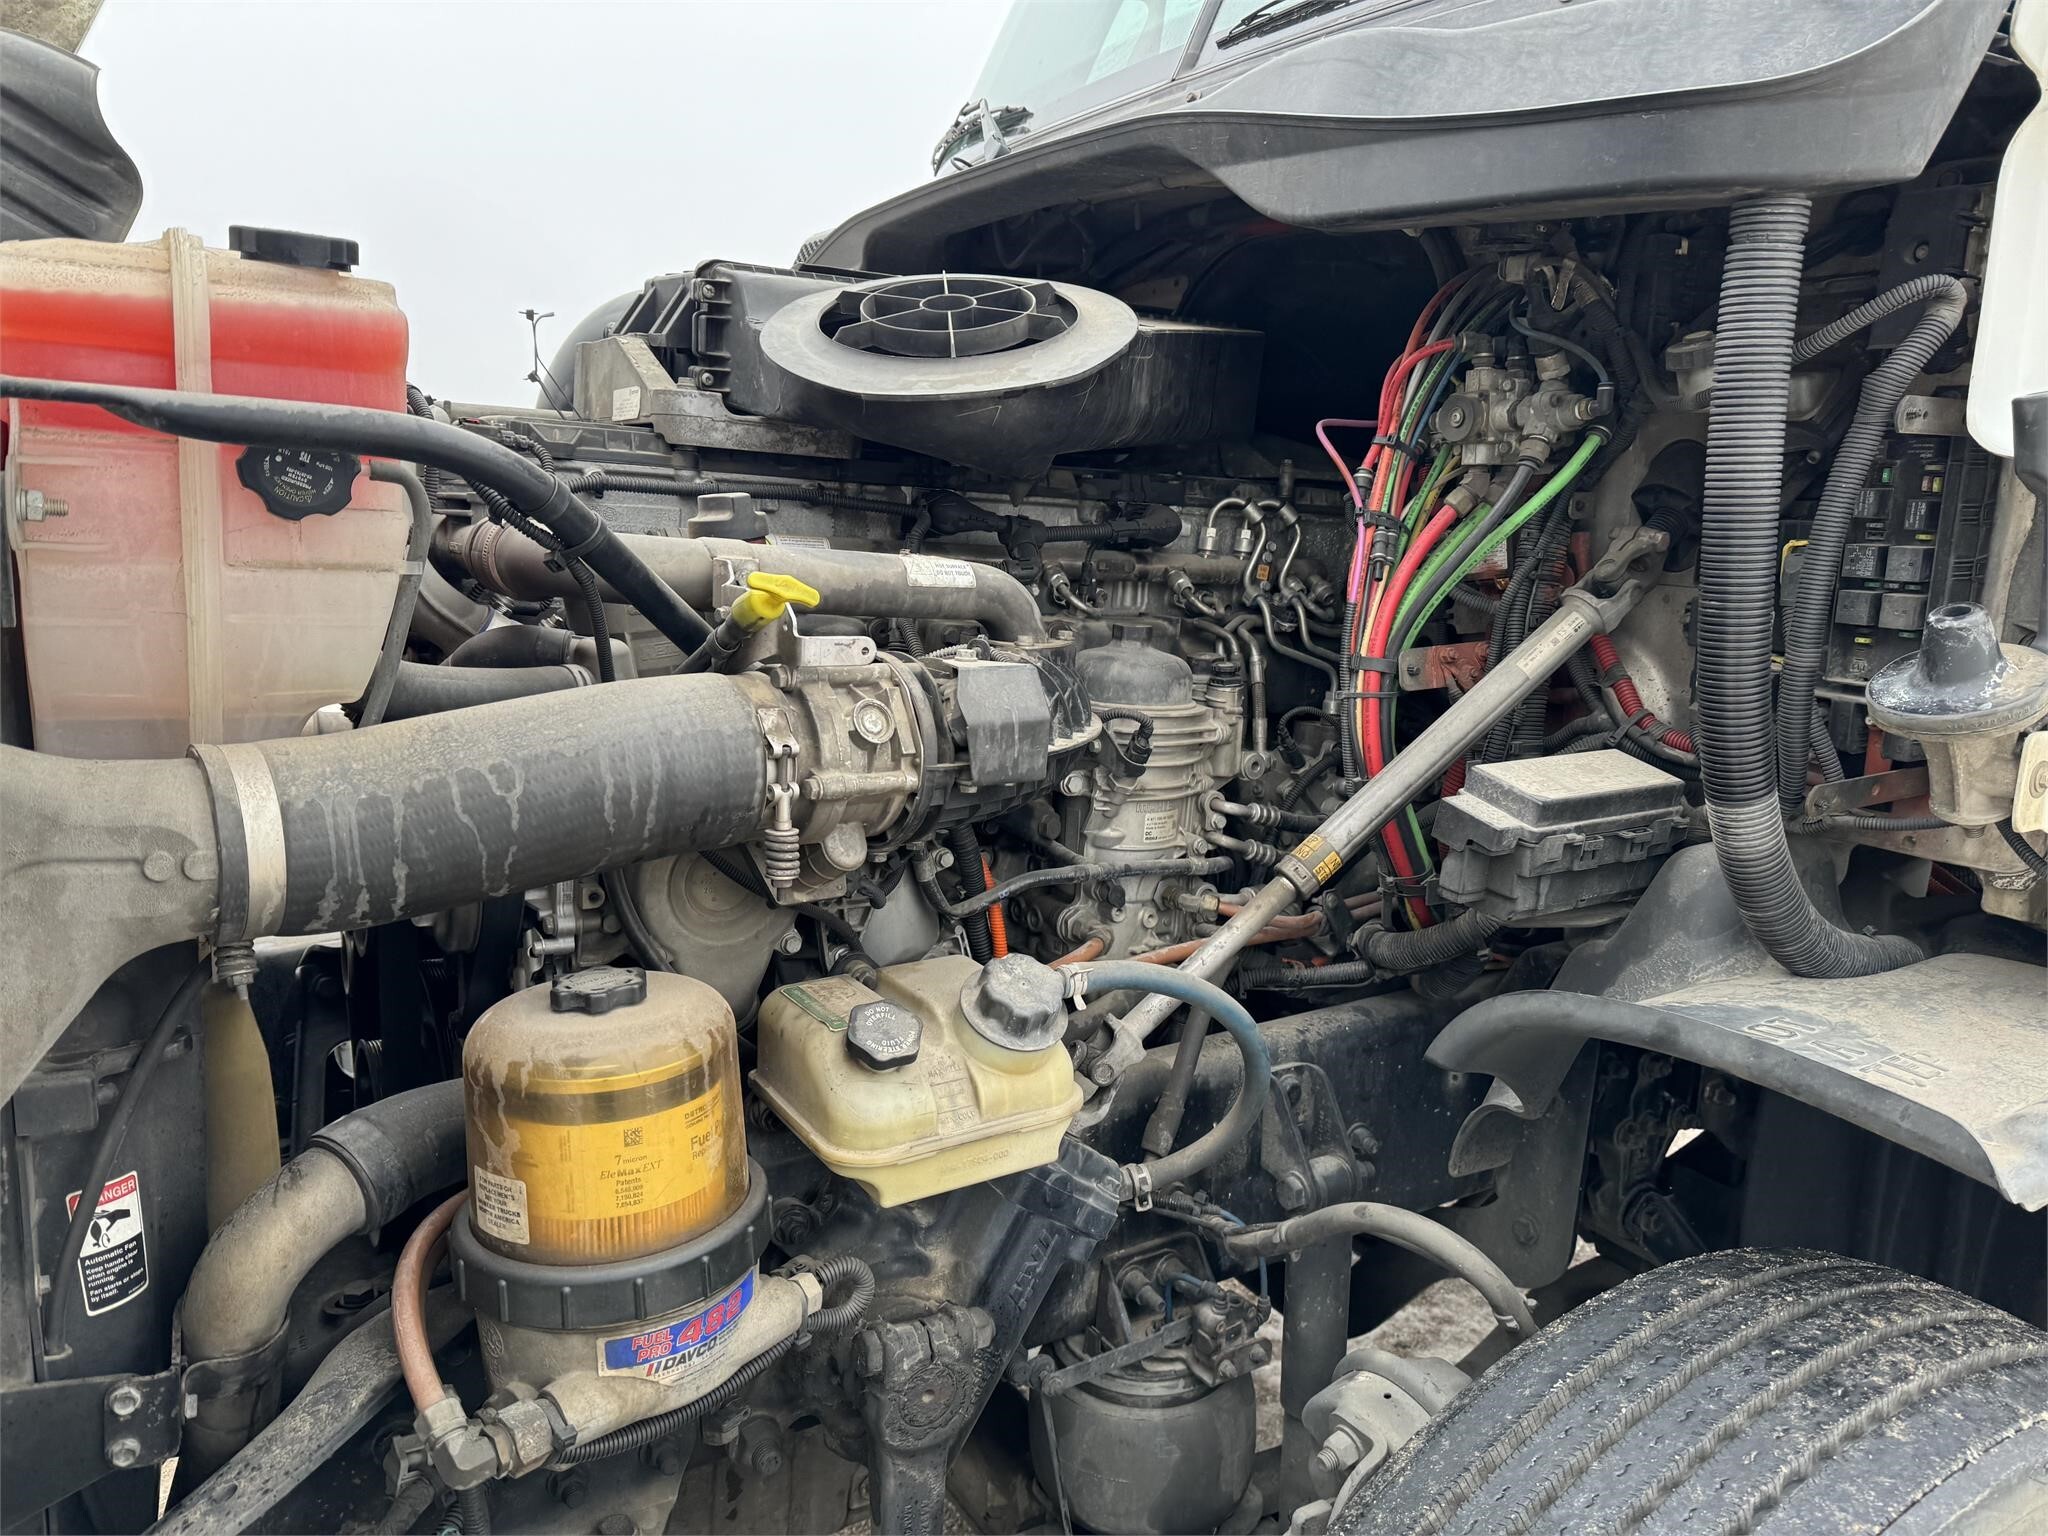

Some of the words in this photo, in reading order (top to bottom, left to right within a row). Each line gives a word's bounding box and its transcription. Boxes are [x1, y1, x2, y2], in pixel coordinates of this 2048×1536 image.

[274, 486, 305, 503] CAUTION
[863, 1008, 875, 1017] DO
[865, 1012, 896, 1026] OVERFILL
[866, 1040, 901, 1053] STEERING
[614, 1155, 622, 1167] 7
[622, 1154, 648, 1165] micron
[616, 1177, 642, 1187] Patents
[493, 1212, 521, 1226] AMERICA
[496, 1206, 521, 1218] TRUCKS
[85, 1247, 123, 1267] Automatic
[124, 1241, 137, 1251] Fan
[85, 1265, 104, 1275] Keep
[104, 1257, 124, 1269] hands
[124, 1249, 138, 1260] clear
[87, 1272, 105, 1282] when
[106, 1262, 128, 1275] engine
[88, 1274, 116, 1288] running.
[89, 1289, 103, 1297] Fan
[104, 1280, 123, 1292] starts
[90, 1295, 100, 1303] by
[100, 1288, 119, 1300] itself.
[632, 1328, 674, 1350] FUEL
[676, 1287, 743, 1347] 482
[636, 1341, 673, 1363] PRO
[661, 1335, 718, 1371] DAVCO
